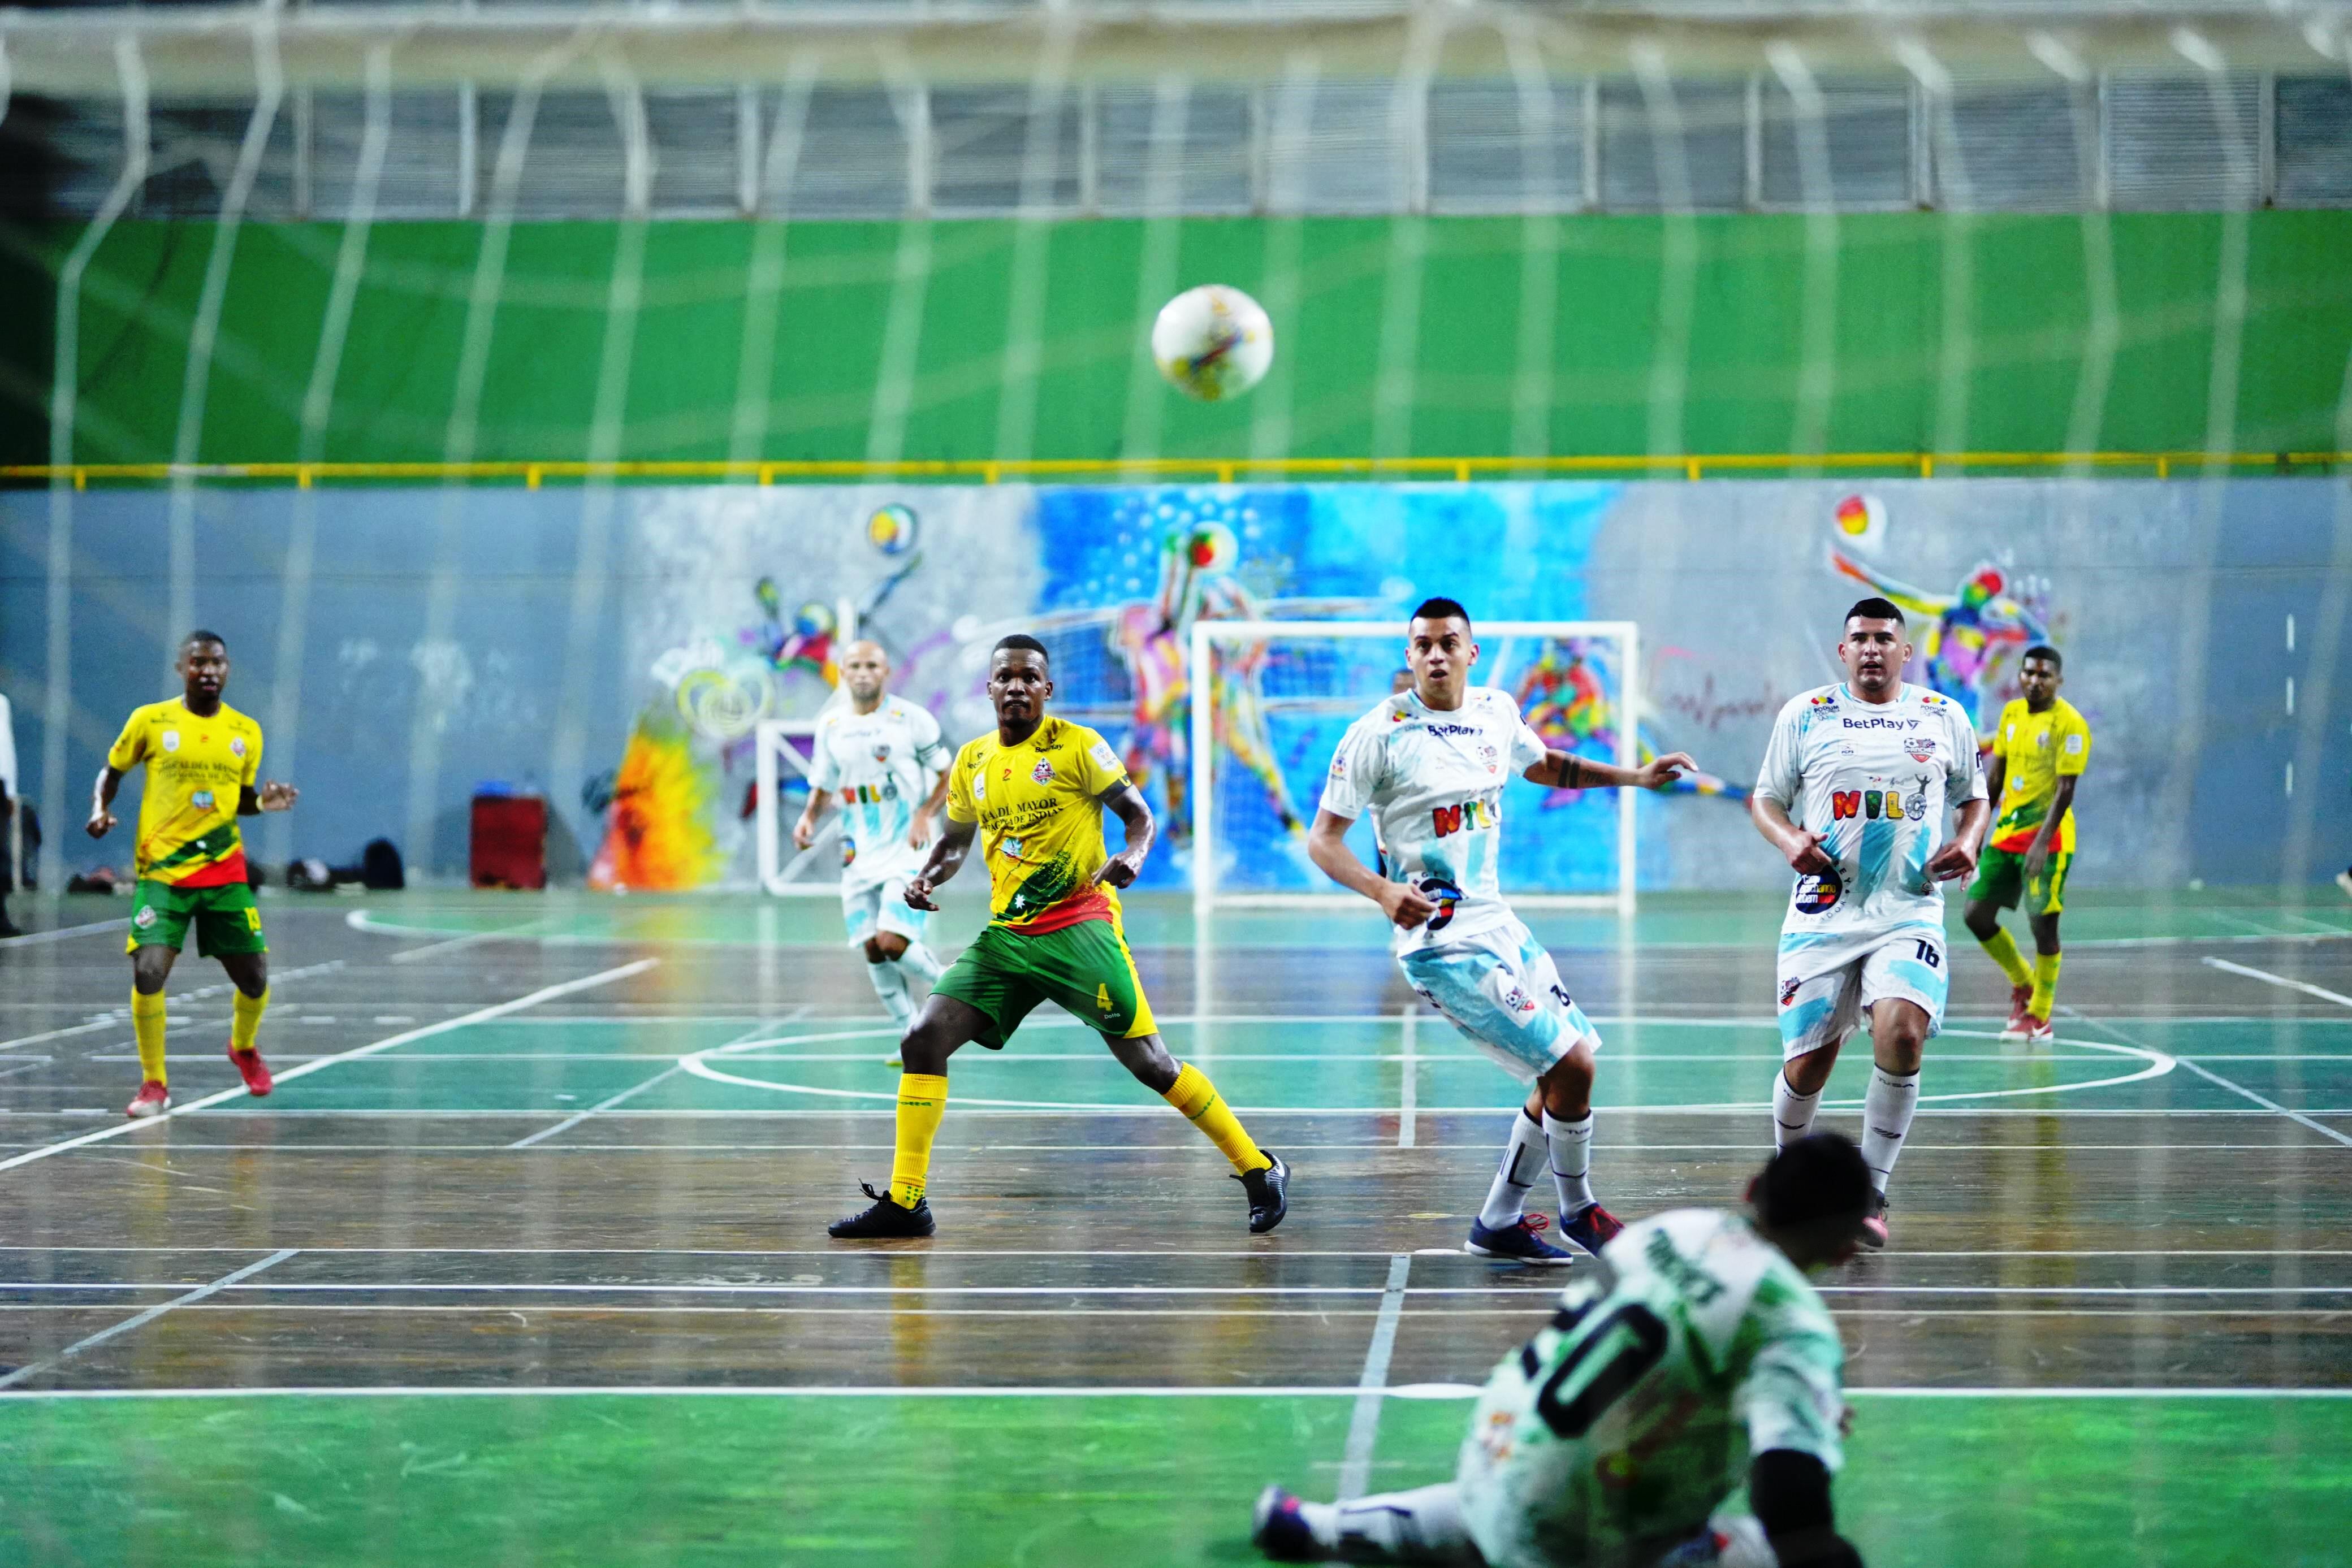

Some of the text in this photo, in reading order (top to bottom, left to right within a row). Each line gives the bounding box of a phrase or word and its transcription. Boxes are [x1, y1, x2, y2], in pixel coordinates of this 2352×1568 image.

[1843, 718, 1904, 730] BetPlay
[1017, 798, 1057, 812] MAYOR
[1832, 790, 1927, 821] NILO
[1916, 939, 1940, 968] 16
[1097, 983, 1113, 1011] 4
